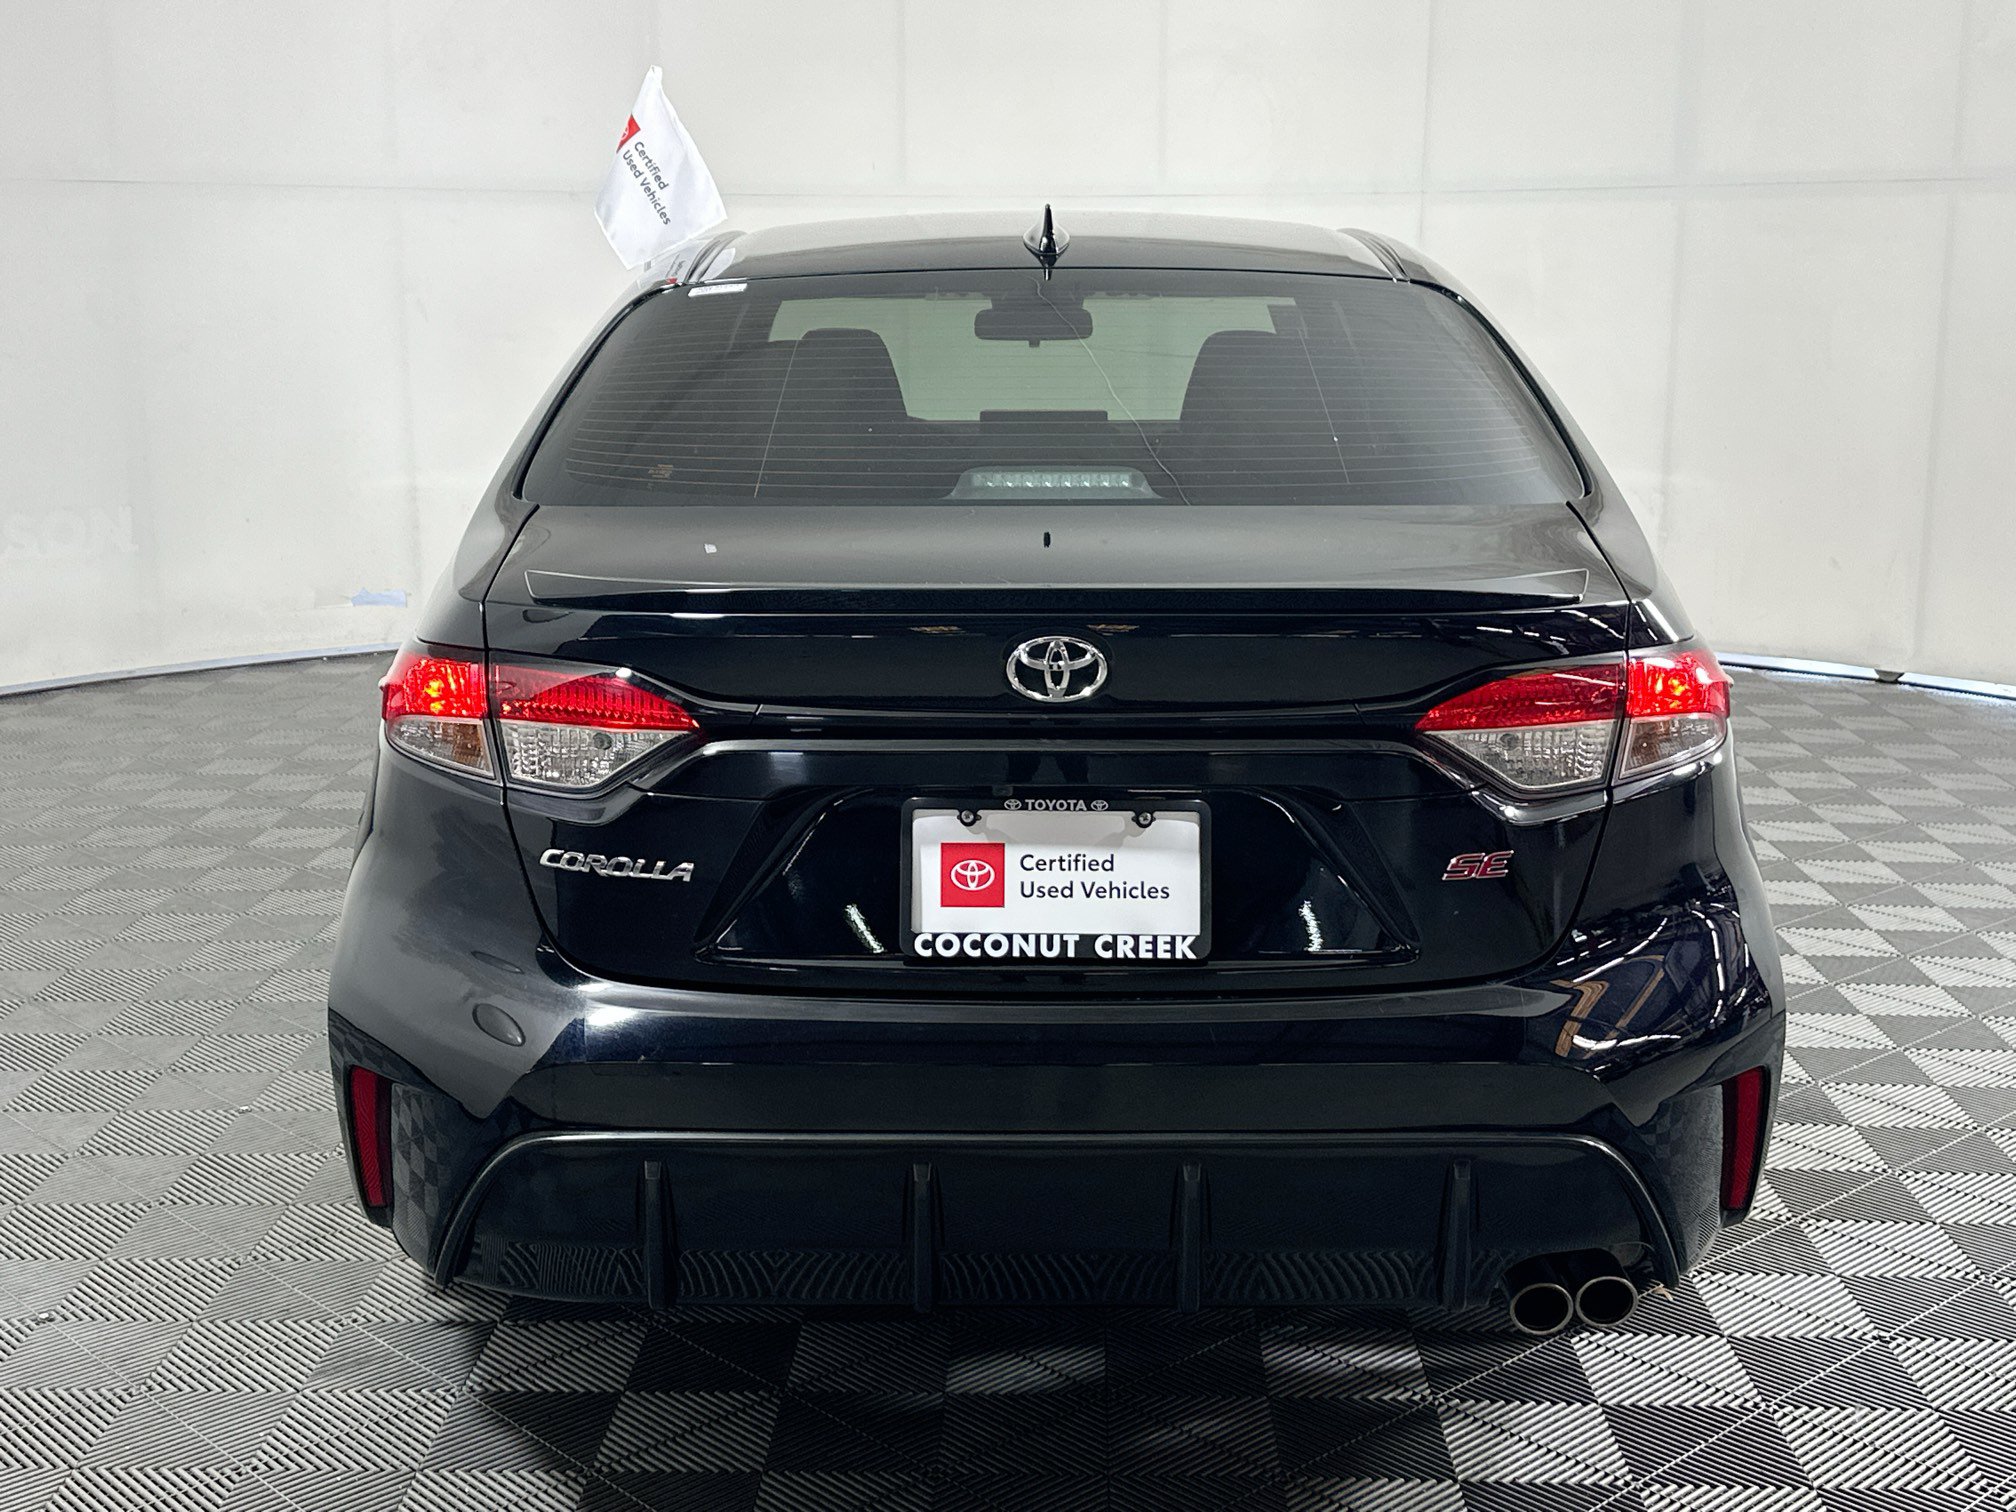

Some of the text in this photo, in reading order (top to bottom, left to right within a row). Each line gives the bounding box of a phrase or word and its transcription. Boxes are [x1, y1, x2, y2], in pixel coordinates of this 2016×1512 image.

[634, 141, 669, 191] Certified
[622, 149, 671, 225] Used Vehicles
[1025, 799, 1087, 811] TOYOTA
[540, 849, 694, 882] COROLLA
[1020, 854, 1115, 872] Certified
[1442, 850, 1514, 880] SE
[1020, 880, 1170, 899] Used Vehicles
[914, 932, 1198, 960] COCONUT CREEK
